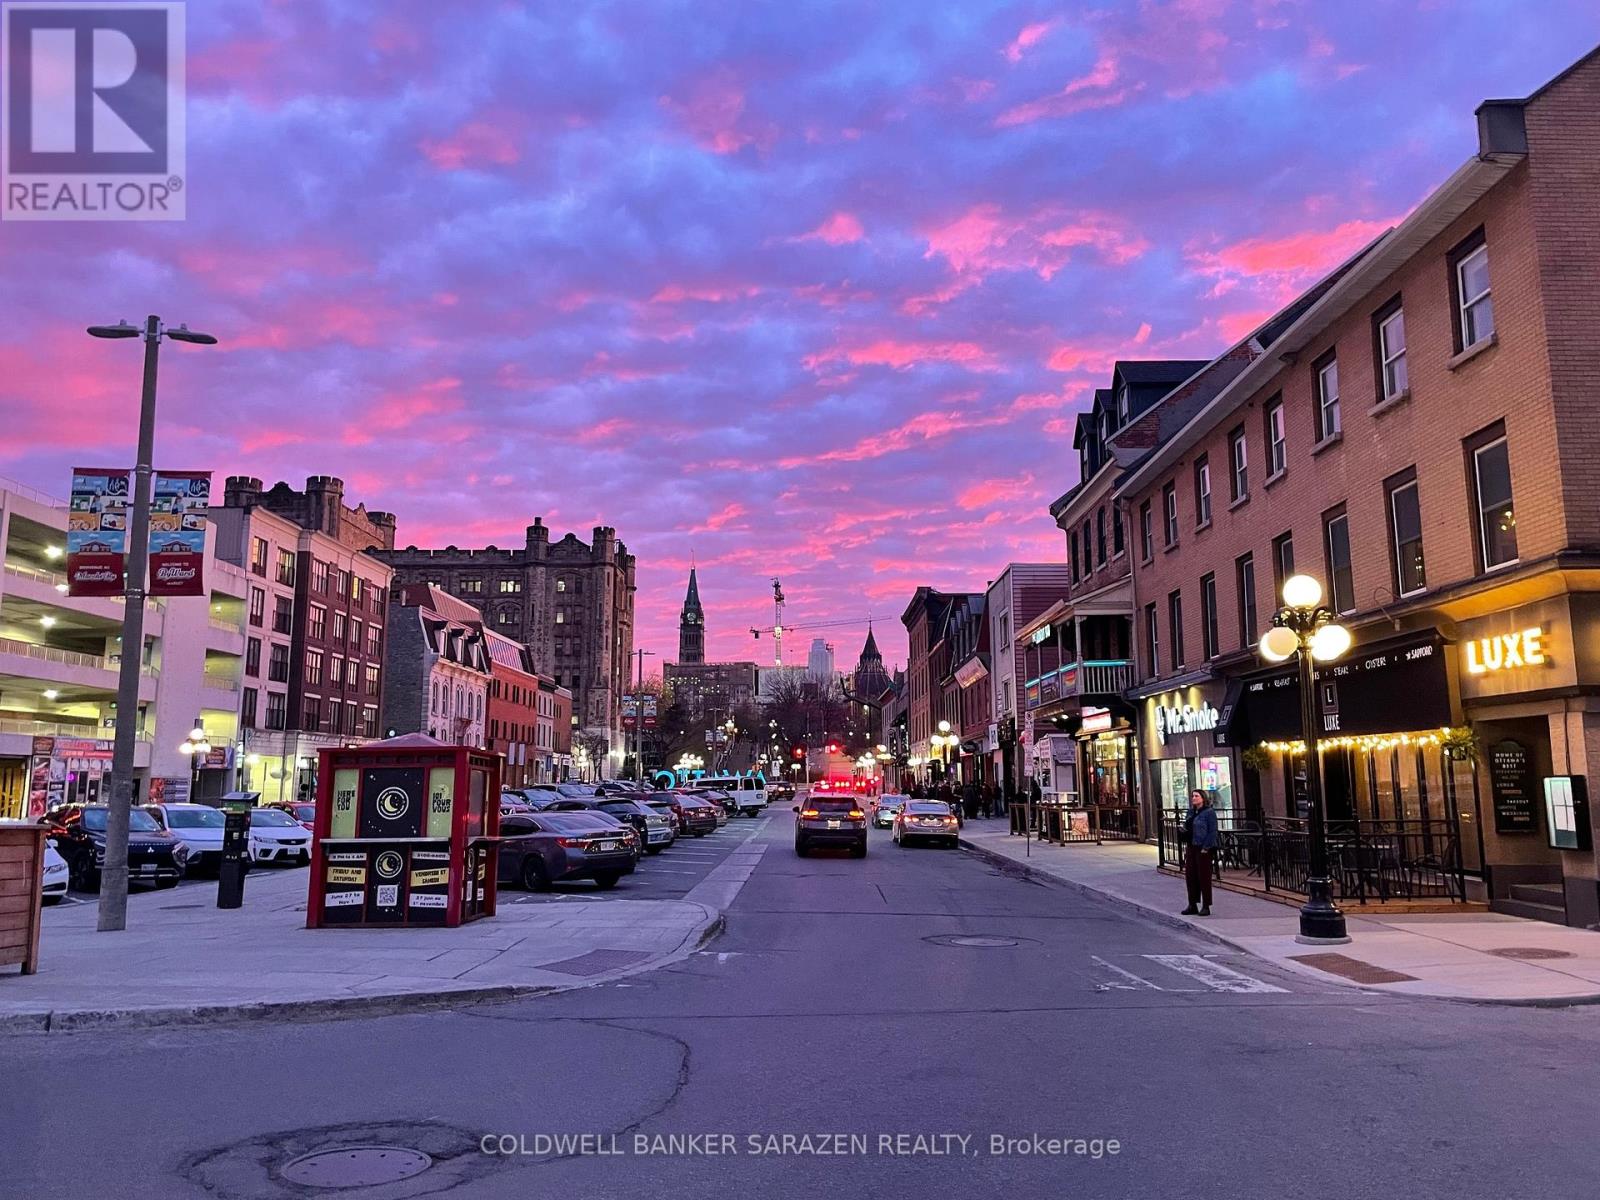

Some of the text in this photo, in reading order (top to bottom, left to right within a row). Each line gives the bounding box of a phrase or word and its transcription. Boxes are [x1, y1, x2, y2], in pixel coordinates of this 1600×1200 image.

[157, 567, 195, 581] ByWard
[1467, 627, 1545, 674] LUXE
[105, 719, 113, 727] 2
[1166, 701, 1219, 734] Mr. Smoke
[1323, 714, 1341, 731] LUXE
